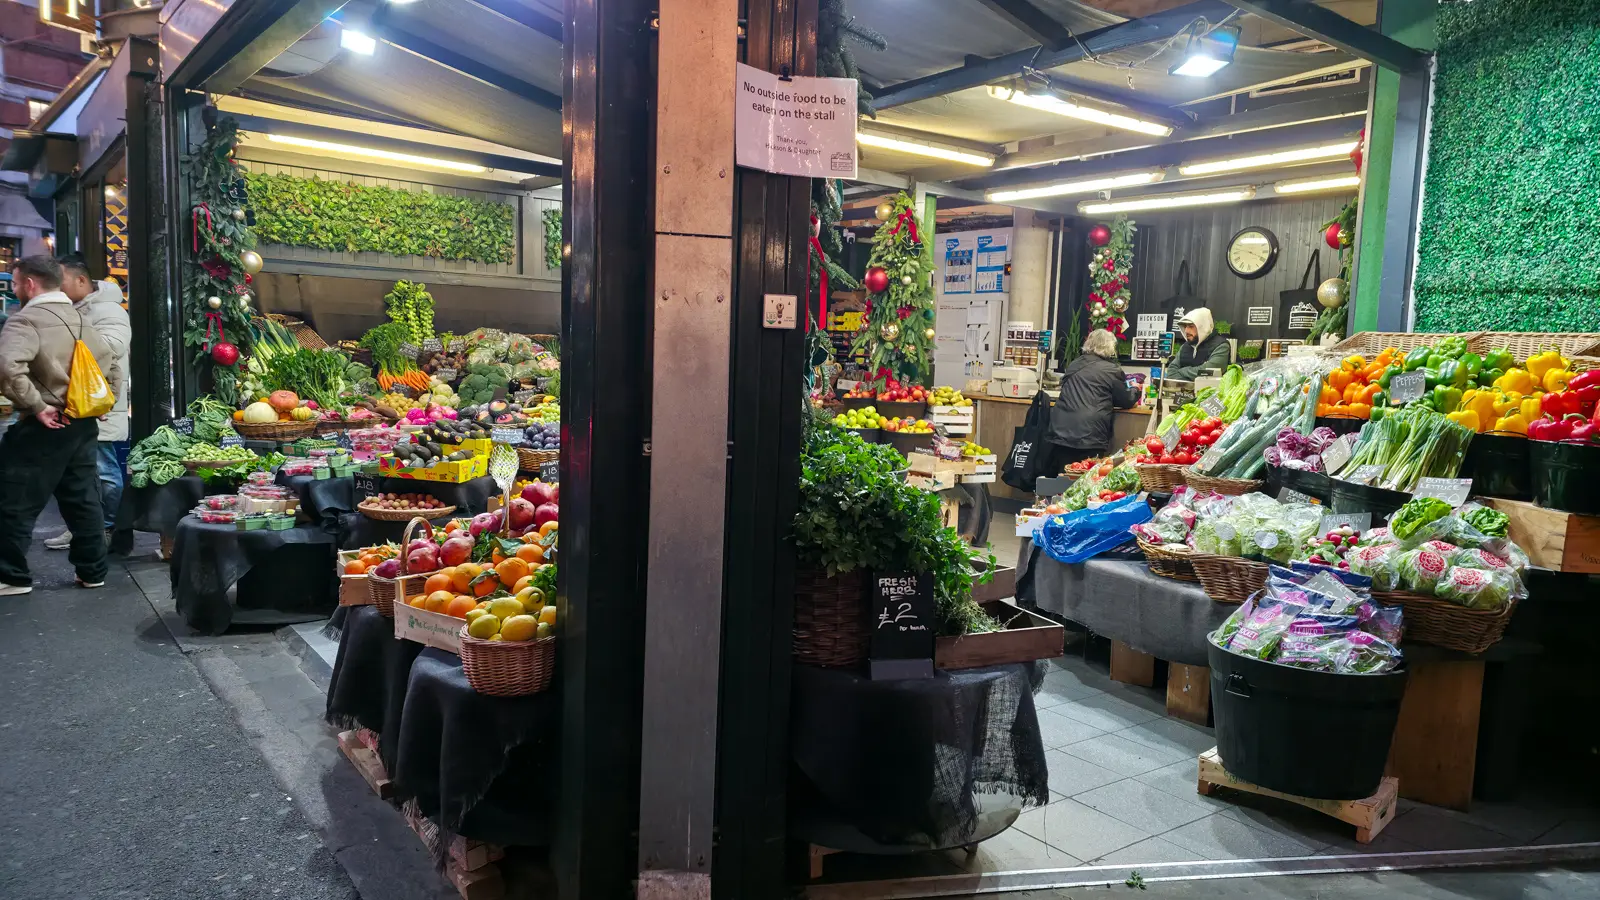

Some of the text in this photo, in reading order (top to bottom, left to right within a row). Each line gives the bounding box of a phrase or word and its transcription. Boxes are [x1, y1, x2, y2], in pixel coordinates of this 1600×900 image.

[743, 81, 847, 105] No outside food to be
[752, 102, 835, 121] eaten on the stall
[1395, 371, 1425, 388] PEPPERS
[1419, 482, 1460, 492] LETTUCE
[1325, 514, 1364, 524] RAINBOW
[878, 575, 918, 588] FRESH
[878, 602, 918, 629] £2
